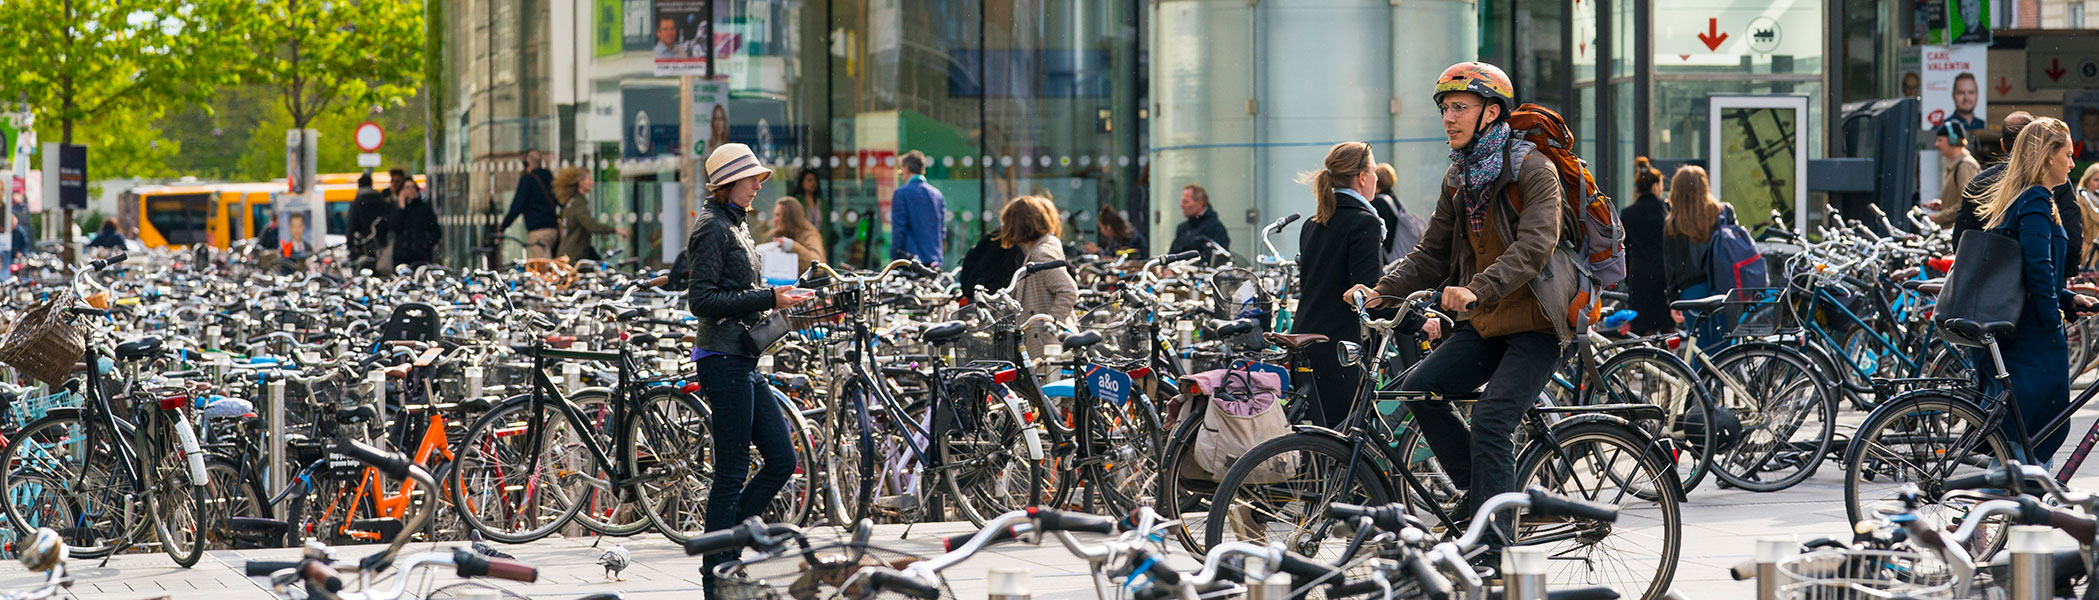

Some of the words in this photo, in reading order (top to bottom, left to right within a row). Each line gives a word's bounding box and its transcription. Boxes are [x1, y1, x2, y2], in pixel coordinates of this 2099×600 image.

[1927, 52, 1949, 60] CARL
[1927, 62, 1970, 71] VALENTIN
[1098, 373, 1119, 392] a&o
